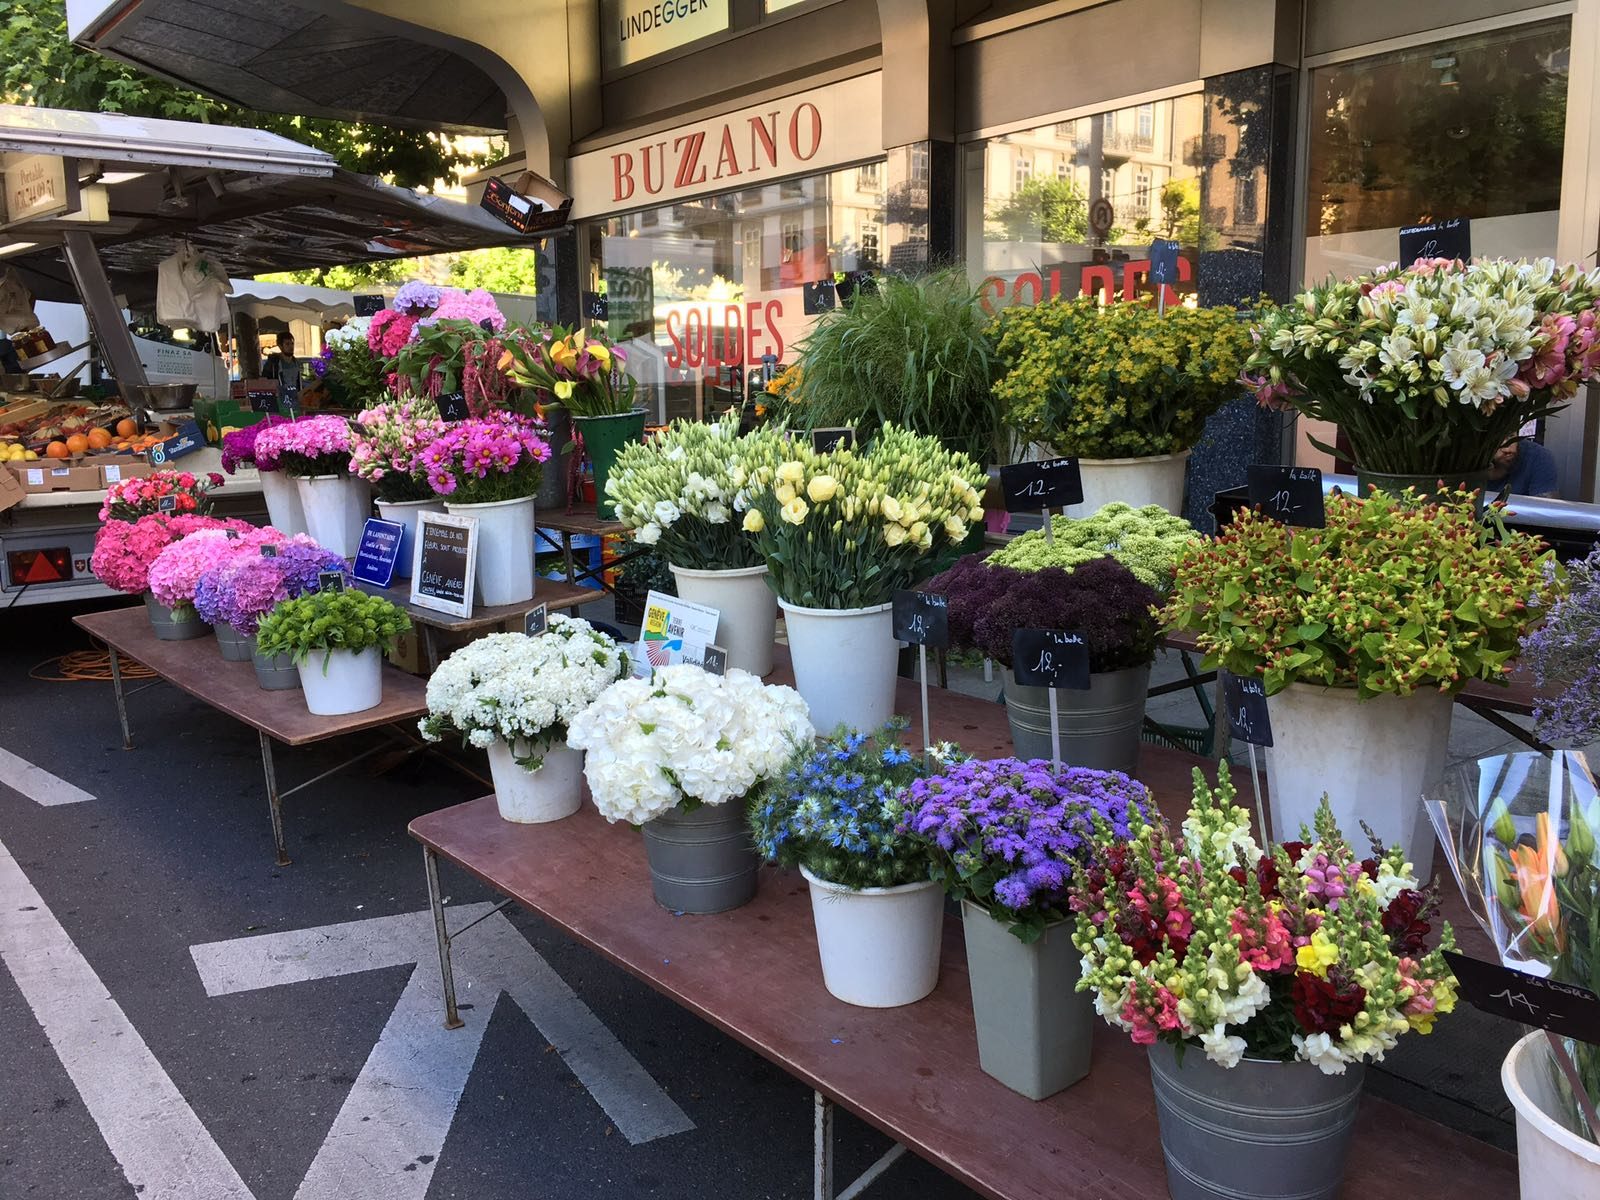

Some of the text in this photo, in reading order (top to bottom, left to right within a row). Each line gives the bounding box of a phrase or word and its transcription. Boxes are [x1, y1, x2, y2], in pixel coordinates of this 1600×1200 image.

[620, 0, 708, 41] LINDEGGER
[611, 102, 822, 202] BUZZANO
[157, 348, 180, 356] FINAZ
[666, 299, 784, 369] SOLDES
